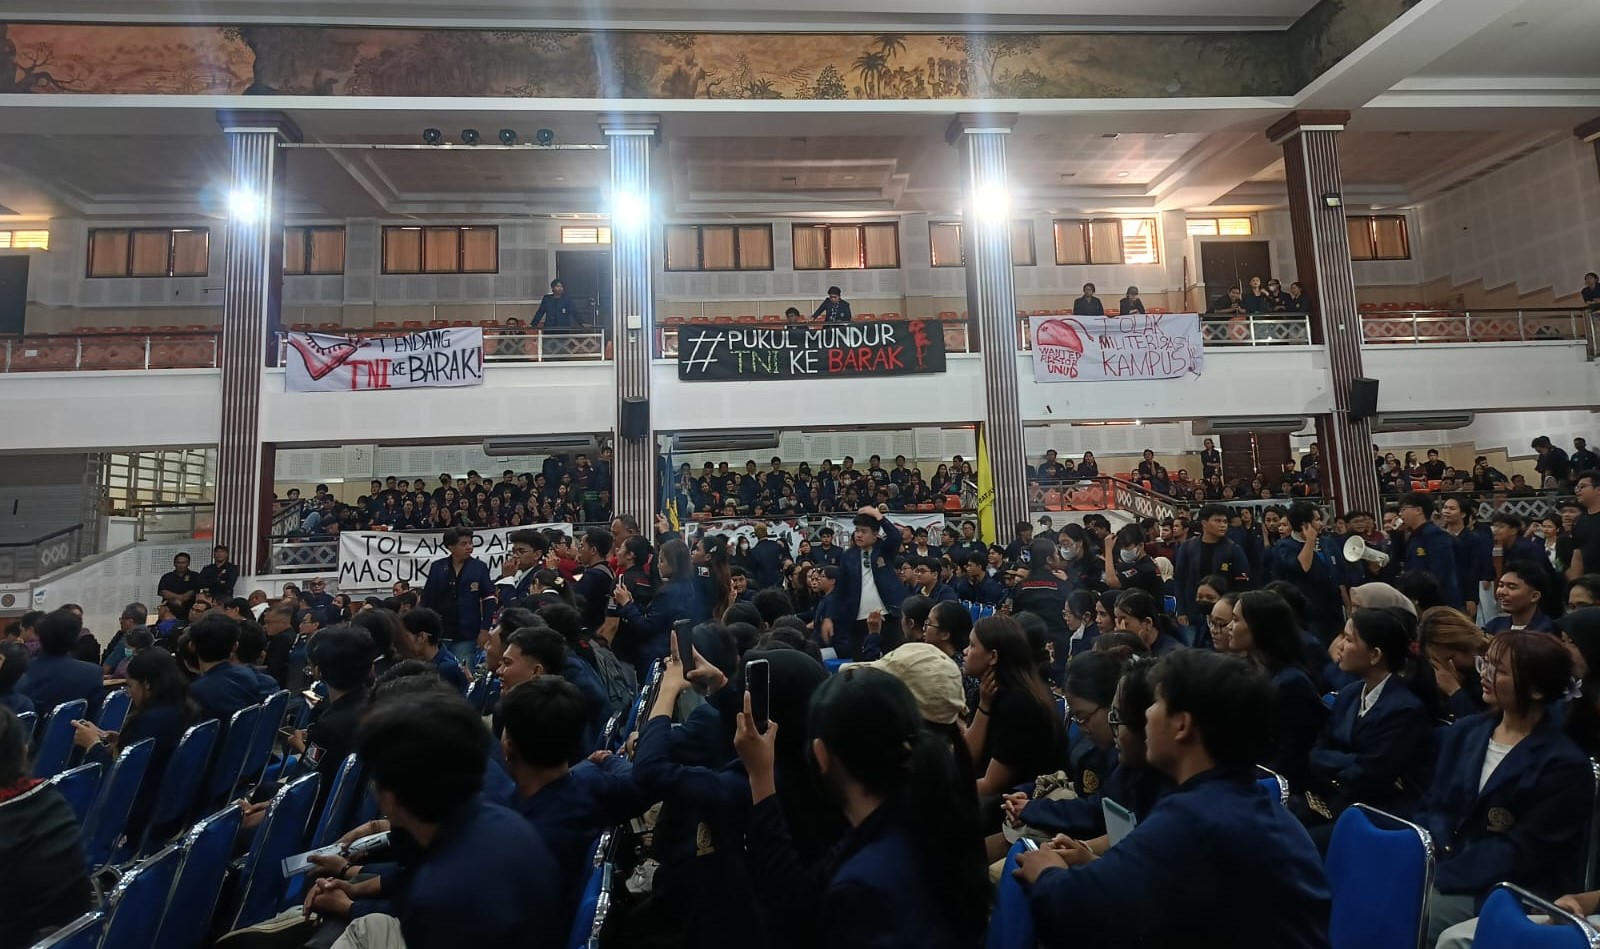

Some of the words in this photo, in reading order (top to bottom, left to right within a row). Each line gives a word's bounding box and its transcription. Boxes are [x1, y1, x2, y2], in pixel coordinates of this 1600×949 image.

[804, 322, 896, 349] MUNDUR
[1094, 314, 1165, 336] TOLAK
[370, 330, 451, 353] TENDANG
[730, 349, 780, 374] TNI
[790, 350, 819, 374] KE
[827, 346, 904, 373] BARAK
[1039, 346, 1082, 360] WANTED
[1040, 354, 1078, 367] REKTOR
[344, 358, 392, 390] TNI
[392, 361, 407, 377] KE
[408, 346, 482, 383] BARAK!
[1047, 364, 1079, 379] UNUD
[361, 535, 449, 556] TOLAK
[338, 558, 431, 584] MASUK
